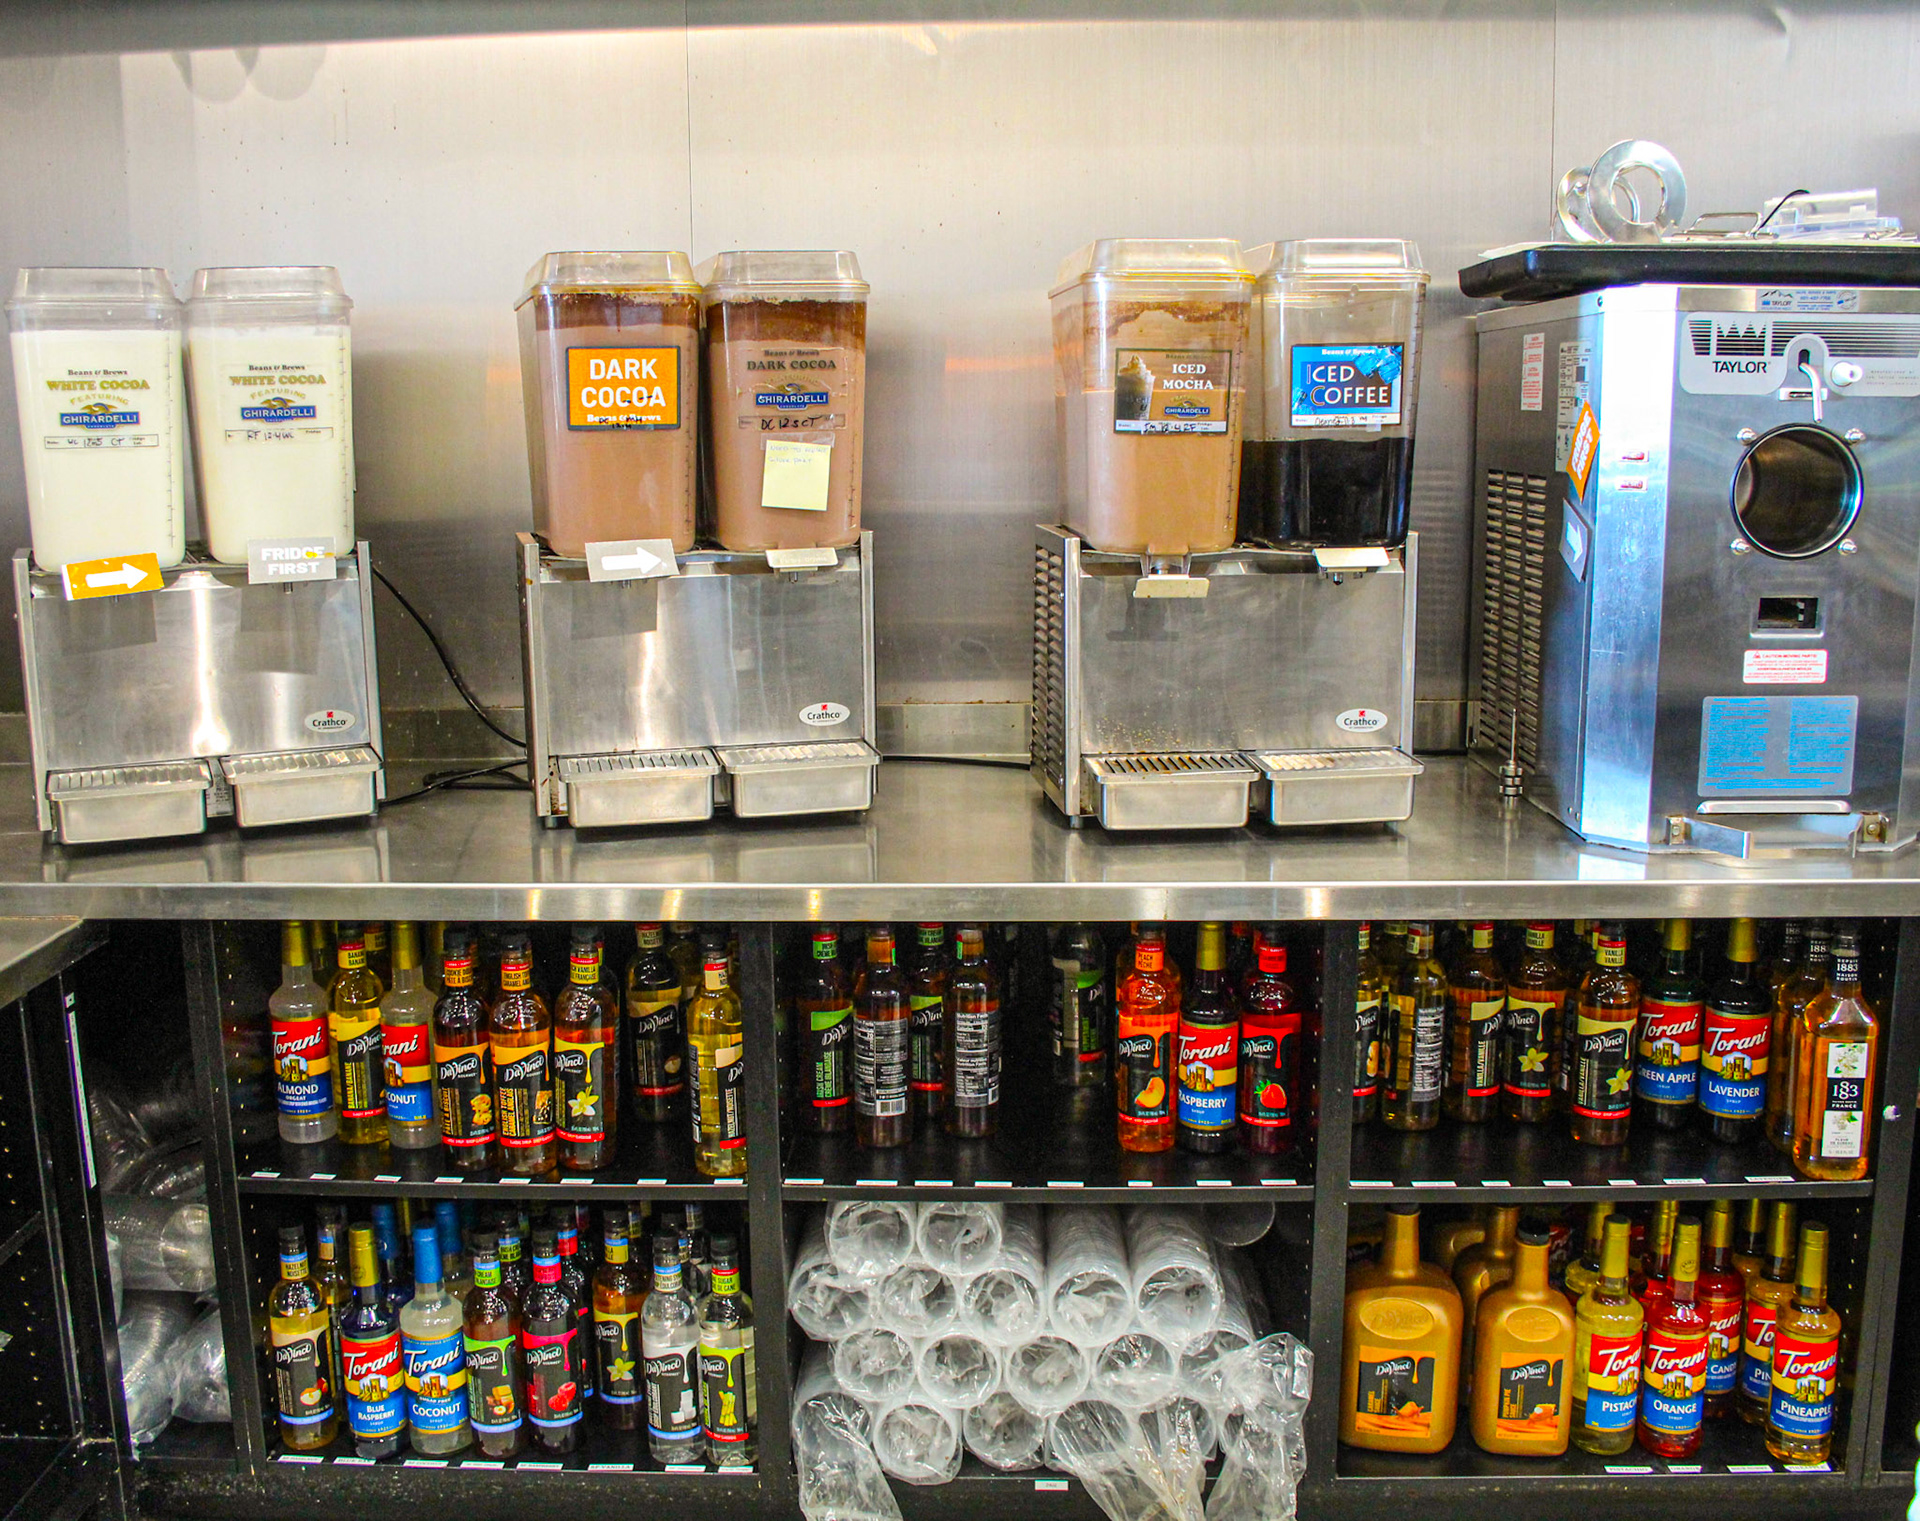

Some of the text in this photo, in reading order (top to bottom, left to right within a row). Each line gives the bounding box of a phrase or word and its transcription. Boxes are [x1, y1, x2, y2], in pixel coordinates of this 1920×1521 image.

[590, 358, 658, 380] DARK
[747, 360, 836, 370] DARK COCOA
[1172, 364, 1206, 374] ICED
[1712, 360, 1768, 374] TAYLOR
[46, 380, 150, 390] WHITE COCOA
[229, 374, 326, 386] WHITE COCOA
[1163, 380, 1214, 390] MOCHA
[70, 393, 129, 406] FEATURING
[581, 386, 666, 408] COCOA
[758, 395, 826, 404] GHIRARDELLI
[1310, 385, 1389, 406] COFFEE
[62, 414, 137, 424] GHIRARDELLI
[244, 408, 314, 418] GHIRARDELLI
[1572, 410, 1592, 472] FRIDGE
[1576, 428, 1594, 480] FIRST
[262, 546, 325, 560] FRIDGE
[268, 562, 320, 576] FIRST
[312, 718, 346, 726] Crathco
[807, 711, 840, 720] Crathco
[1344, 718, 1378, 726] Crathco
[1837, 963, 1858, 972] 1883
[639, 1011, 674, 1033] DaVinci
[912, 1010, 942, 1026] DaVinc
[1641, 1013, 1698, 1040] Torani
[272, 1026, 322, 1059] Torani
[382, 1034, 418, 1055] rani
[1119, 1039, 1152, 1057] DaVinci
[1584, 1032, 1624, 1053] DaVinci
[1708, 1025, 1768, 1056] Torani
[1179, 1036, 1232, 1063] Torani
[440, 1058, 477, 1080] DaVinci
[504, 1054, 544, 1082] DaVinci
[1667, 1072, 1696, 1083] APPLE
[278, 1082, 319, 1095] ALMOND
[1708, 1081, 1760, 1097] LAVENDER
[1832, 1081, 1858, 1100] 1883
[386, 1092, 416, 1104] CONUT
[1178, 1089, 1227, 1108] RASPBERRY
[1710, 1304, 1742, 1330] rani
[276, 1343, 312, 1364] DaVinci
[344, 1341, 399, 1380] Torani
[404, 1340, 460, 1376] Torani
[466, 1352, 499, 1370] DaVinci
[527, 1346, 562, 1366] DaVinci
[1649, 1343, 1707, 1373] Torani
[646, 1358, 681, 1376] DaVinci
[1376, 1360, 1411, 1376] DaVinci
[1779, 1348, 1837, 1377] Torani
[1511, 1364, 1547, 1380] DaVinci
[358, 1410, 395, 1420] RASPBERRY
[366, 1405, 385, 1413] BLUE
[412, 1402, 461, 1417] COCONUT
[1653, 1400, 1697, 1414] ORANGE
[1781, 1400, 1832, 1417] PINEAPPLE
